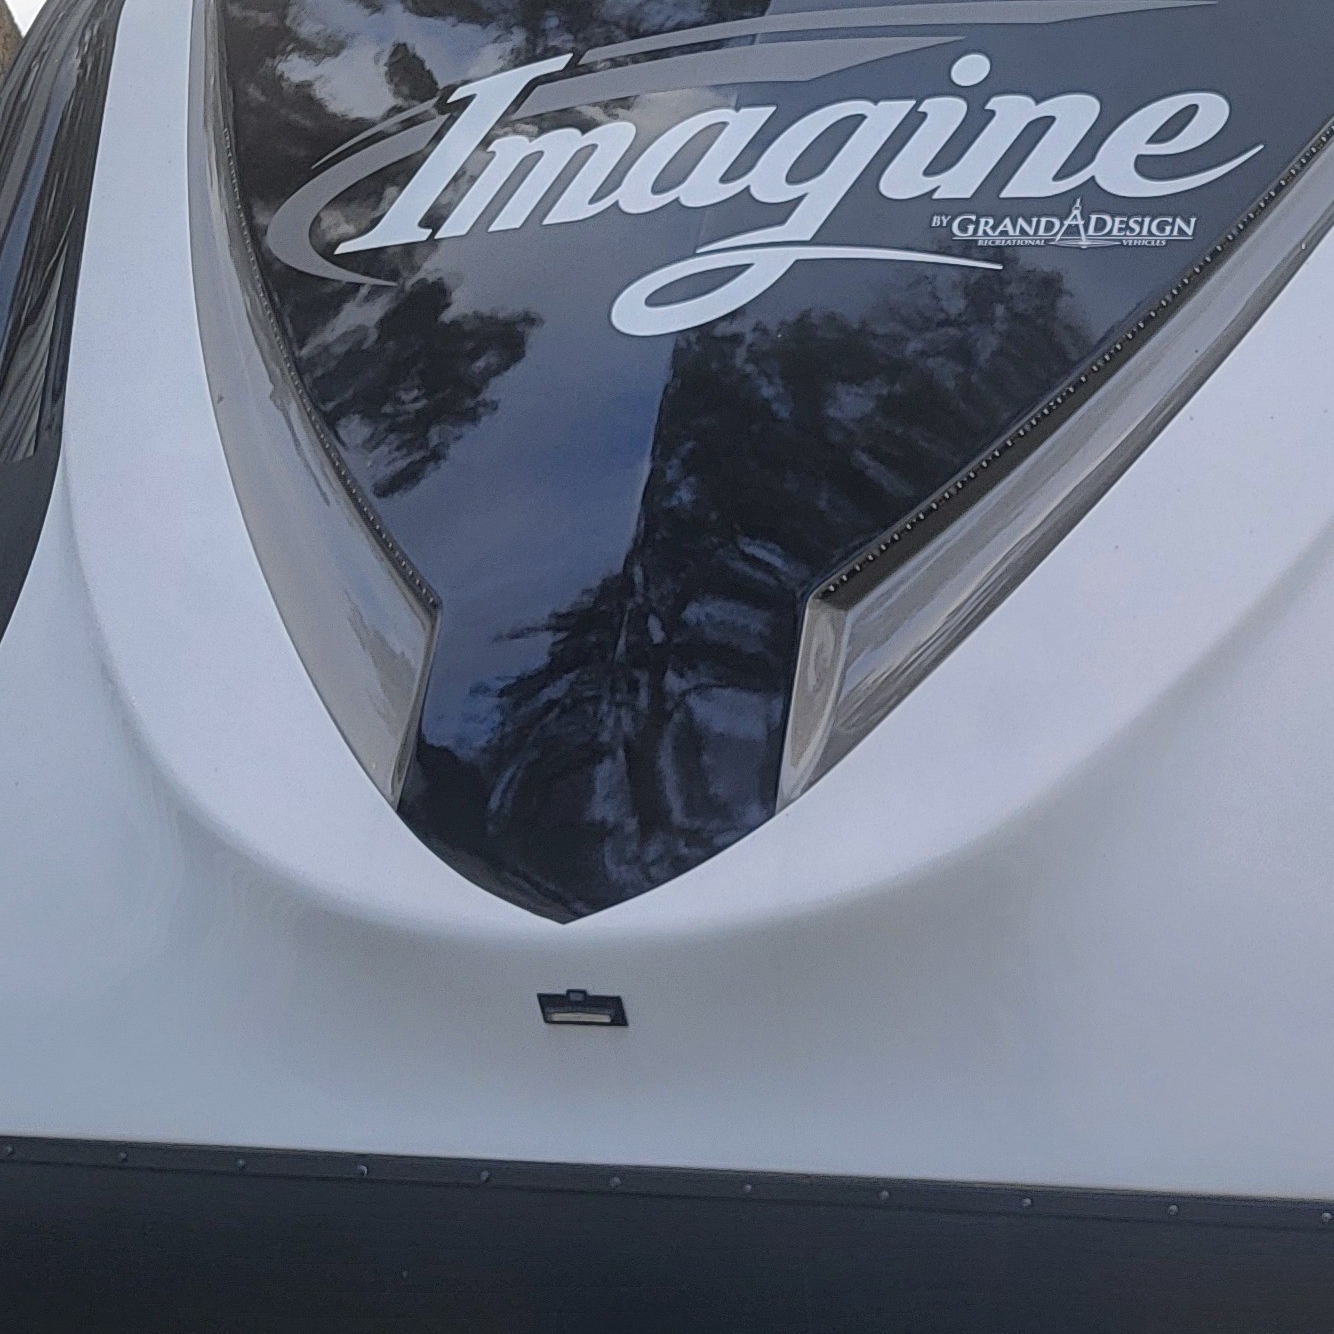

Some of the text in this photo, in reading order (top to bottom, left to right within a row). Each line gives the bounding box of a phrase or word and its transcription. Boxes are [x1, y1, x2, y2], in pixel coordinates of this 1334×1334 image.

[335, 52, 1265, 336] Imagine
[931, 214, 1197, 237] BY GRAND DESIGN
